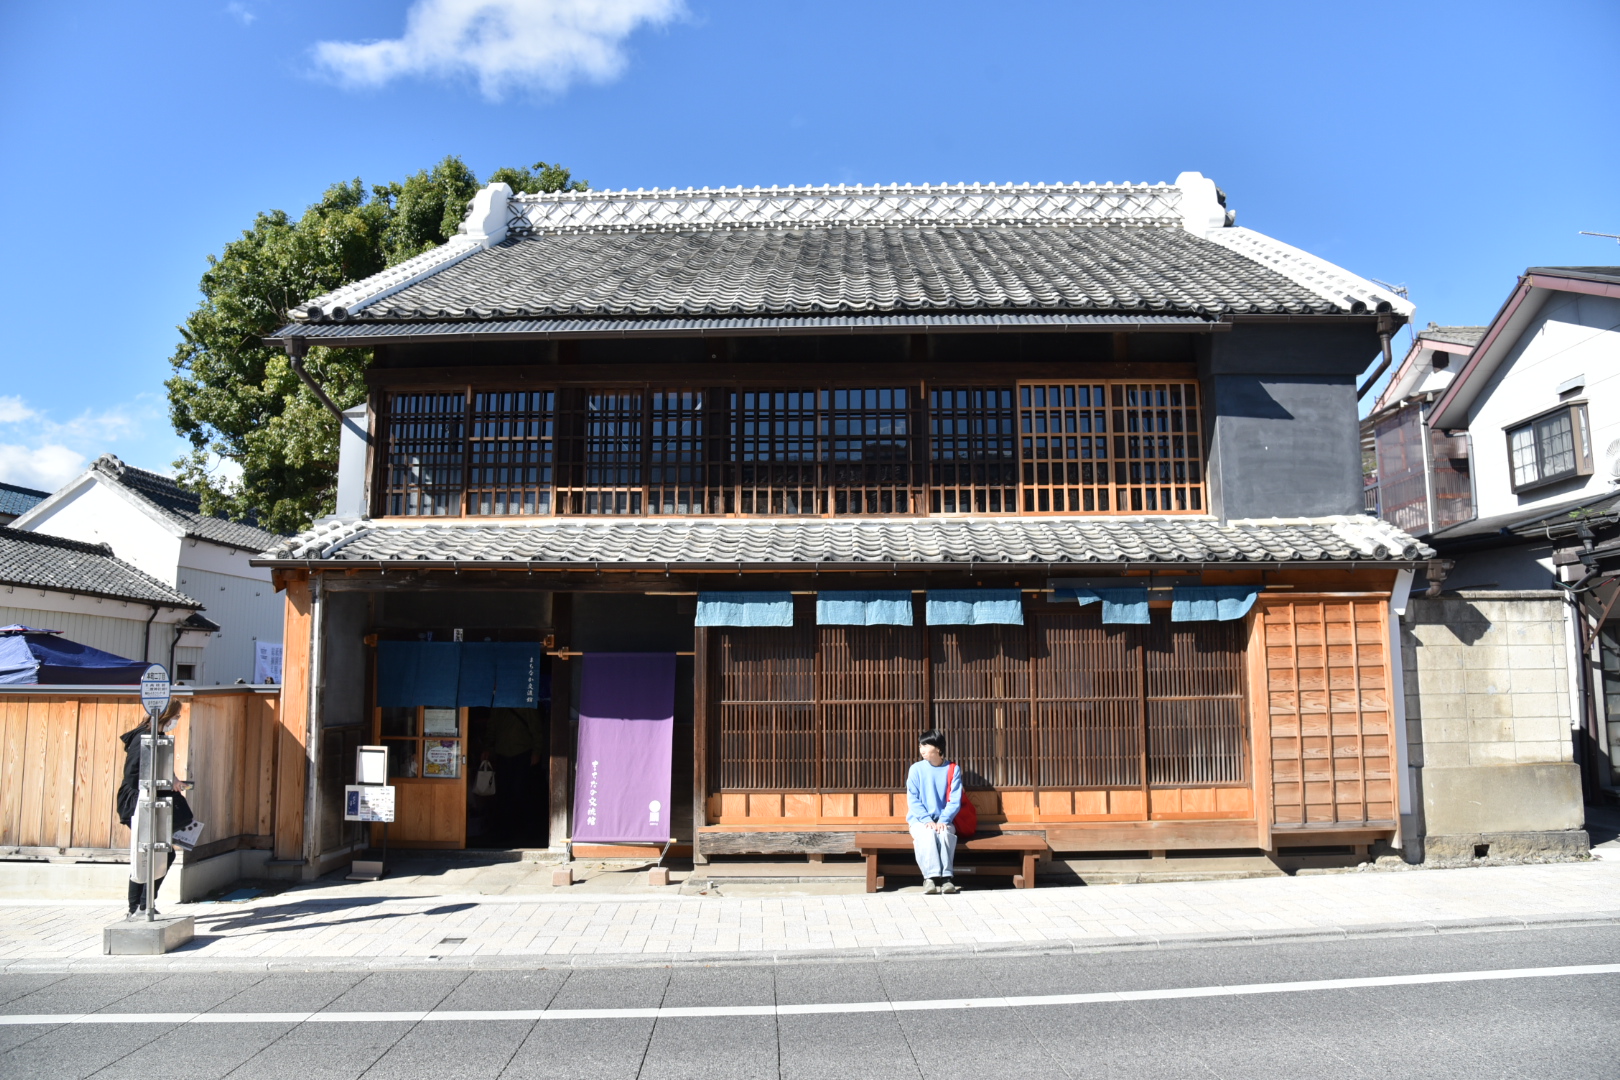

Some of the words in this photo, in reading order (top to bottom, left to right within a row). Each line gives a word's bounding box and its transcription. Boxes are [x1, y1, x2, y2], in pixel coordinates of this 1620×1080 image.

[526, 657, 534, 703] まちなか交流館
[587, 760, 599, 826] まちなか交流館
